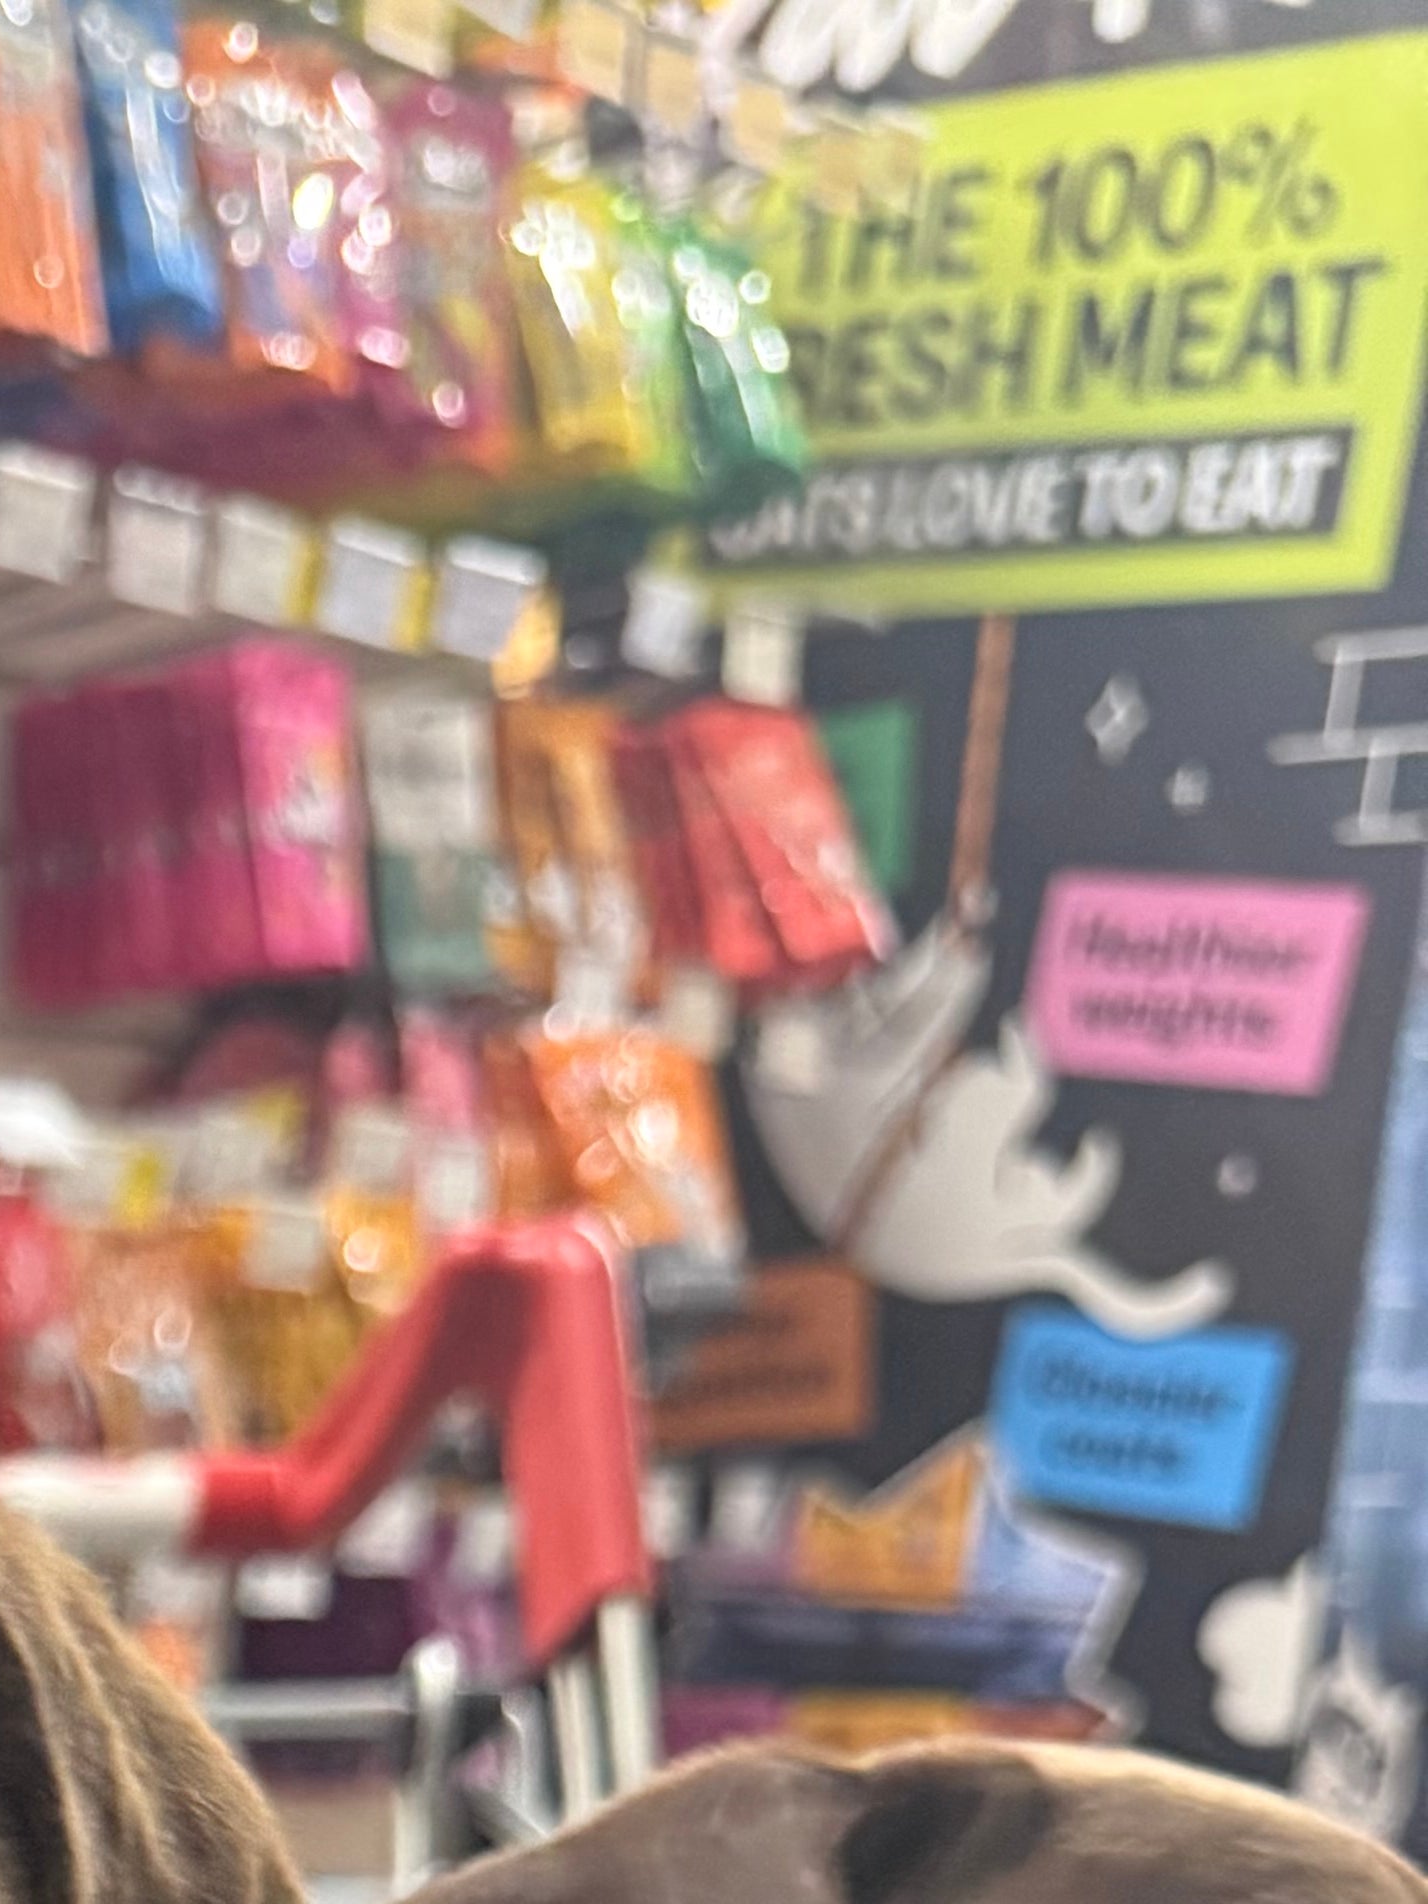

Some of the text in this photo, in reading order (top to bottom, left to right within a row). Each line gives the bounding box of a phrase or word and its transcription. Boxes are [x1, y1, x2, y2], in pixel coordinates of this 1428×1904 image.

[796, 118, 1340, 298] THE 100%
[785, 255, 1387, 430] RESH MEAT
[882, 454, 1068, 550] LOVE
[1074, 447, 1179, 538] TO
[1181, 434, 1336, 533] EAT
